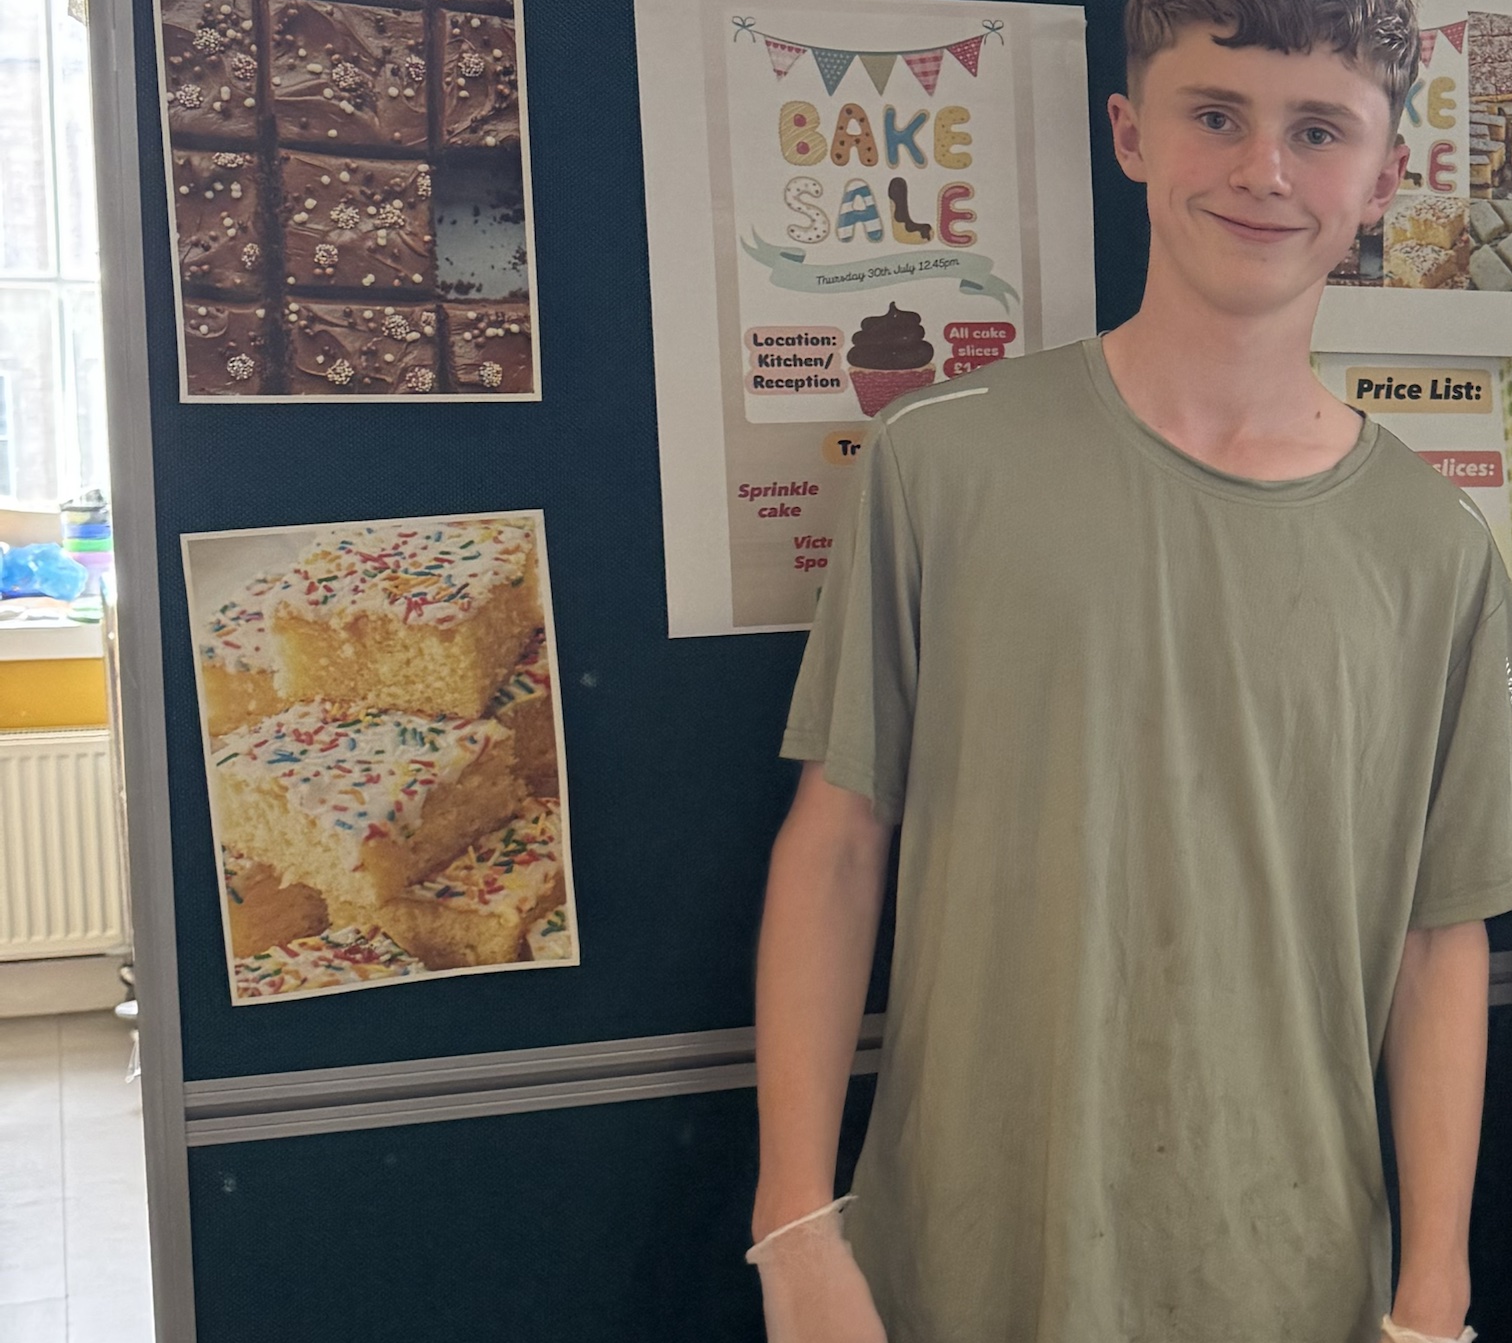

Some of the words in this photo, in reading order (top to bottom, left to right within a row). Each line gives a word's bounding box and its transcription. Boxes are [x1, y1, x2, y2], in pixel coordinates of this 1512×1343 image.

[1405, 76, 1456, 130] KE
[778, 100, 973, 170] BAKE
[783, 175, 977, 248] SALE
[816, 270, 866, 286] Thursday
[867, 265, 892, 279] 30th
[893, 262, 916, 277] July
[753, 333, 838, 347] Location:
[949, 327, 969, 339] All
[972, 327, 1007, 339] cake
[958, 345, 999, 357] slices
[757, 352, 834, 369] Kitchen/
[753, 375, 841, 393] Reception
[1356, 376, 1422, 400] Price
[1429, 377, 1482, 401] List:
[837, 439, 861, 456] Tr
[1432, 458, 1495, 477] slices:
[738, 481, 819, 502] Sprinkle
[758, 504, 802, 519] cake
[794, 536, 832, 549] Vict
[794, 555, 828, 572] Spo
